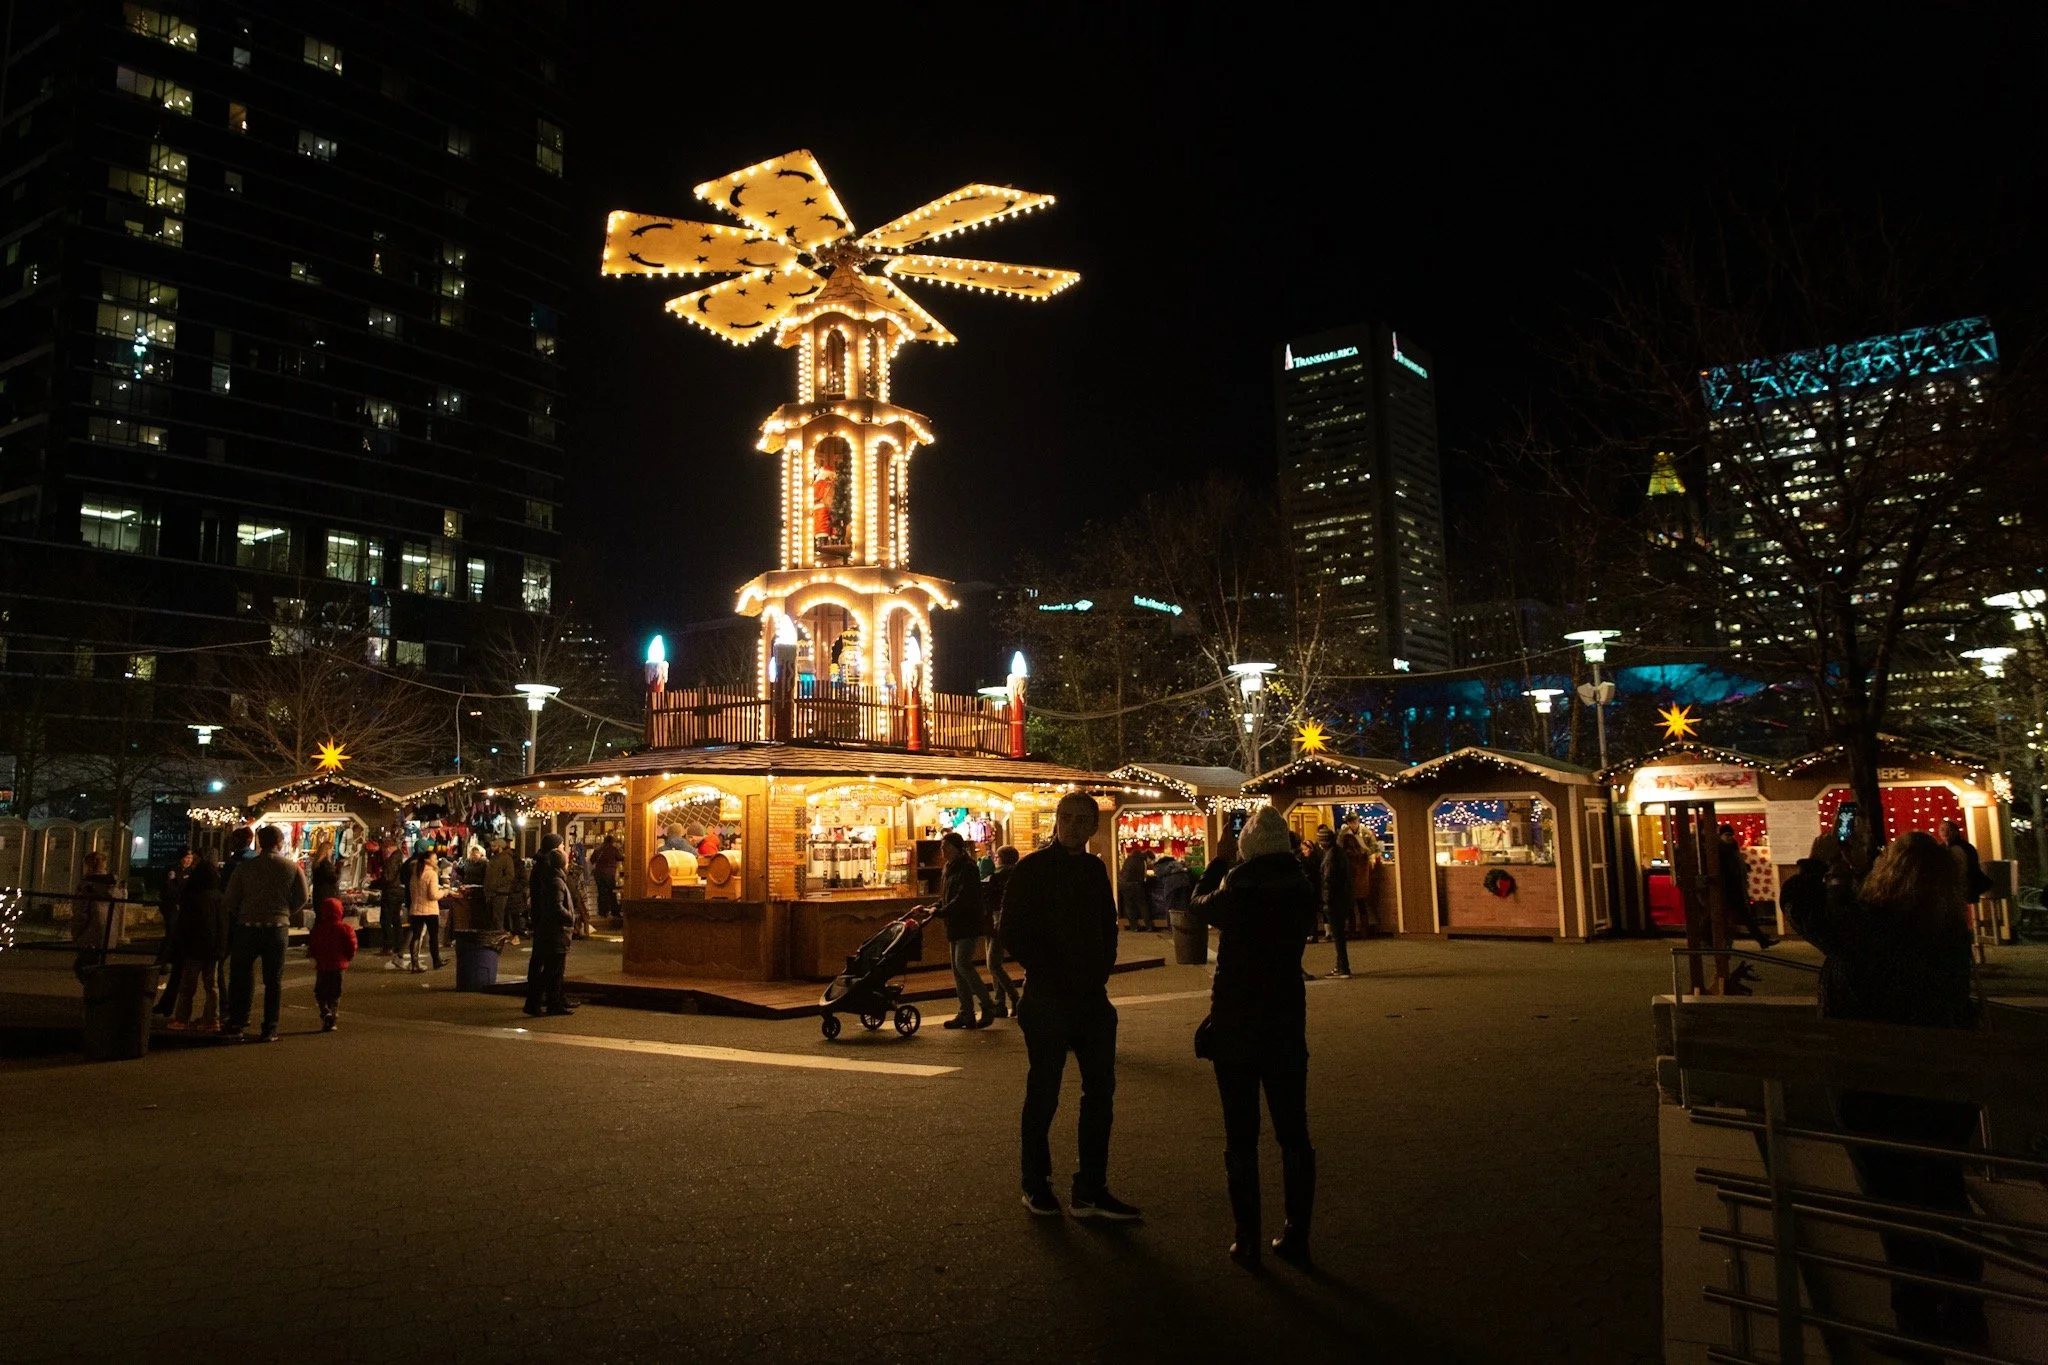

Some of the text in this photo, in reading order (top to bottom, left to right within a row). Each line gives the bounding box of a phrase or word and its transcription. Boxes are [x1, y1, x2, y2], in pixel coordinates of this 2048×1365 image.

[1293, 346, 1359, 368] TRANSAMERICA
[1295, 784, 1378, 796] THE NUT ROASTERS
[279, 803, 346, 813] WOOL AND FELT
[559, 797, 600, 810] Chocolate
[603, 804, 623, 813] BARN
